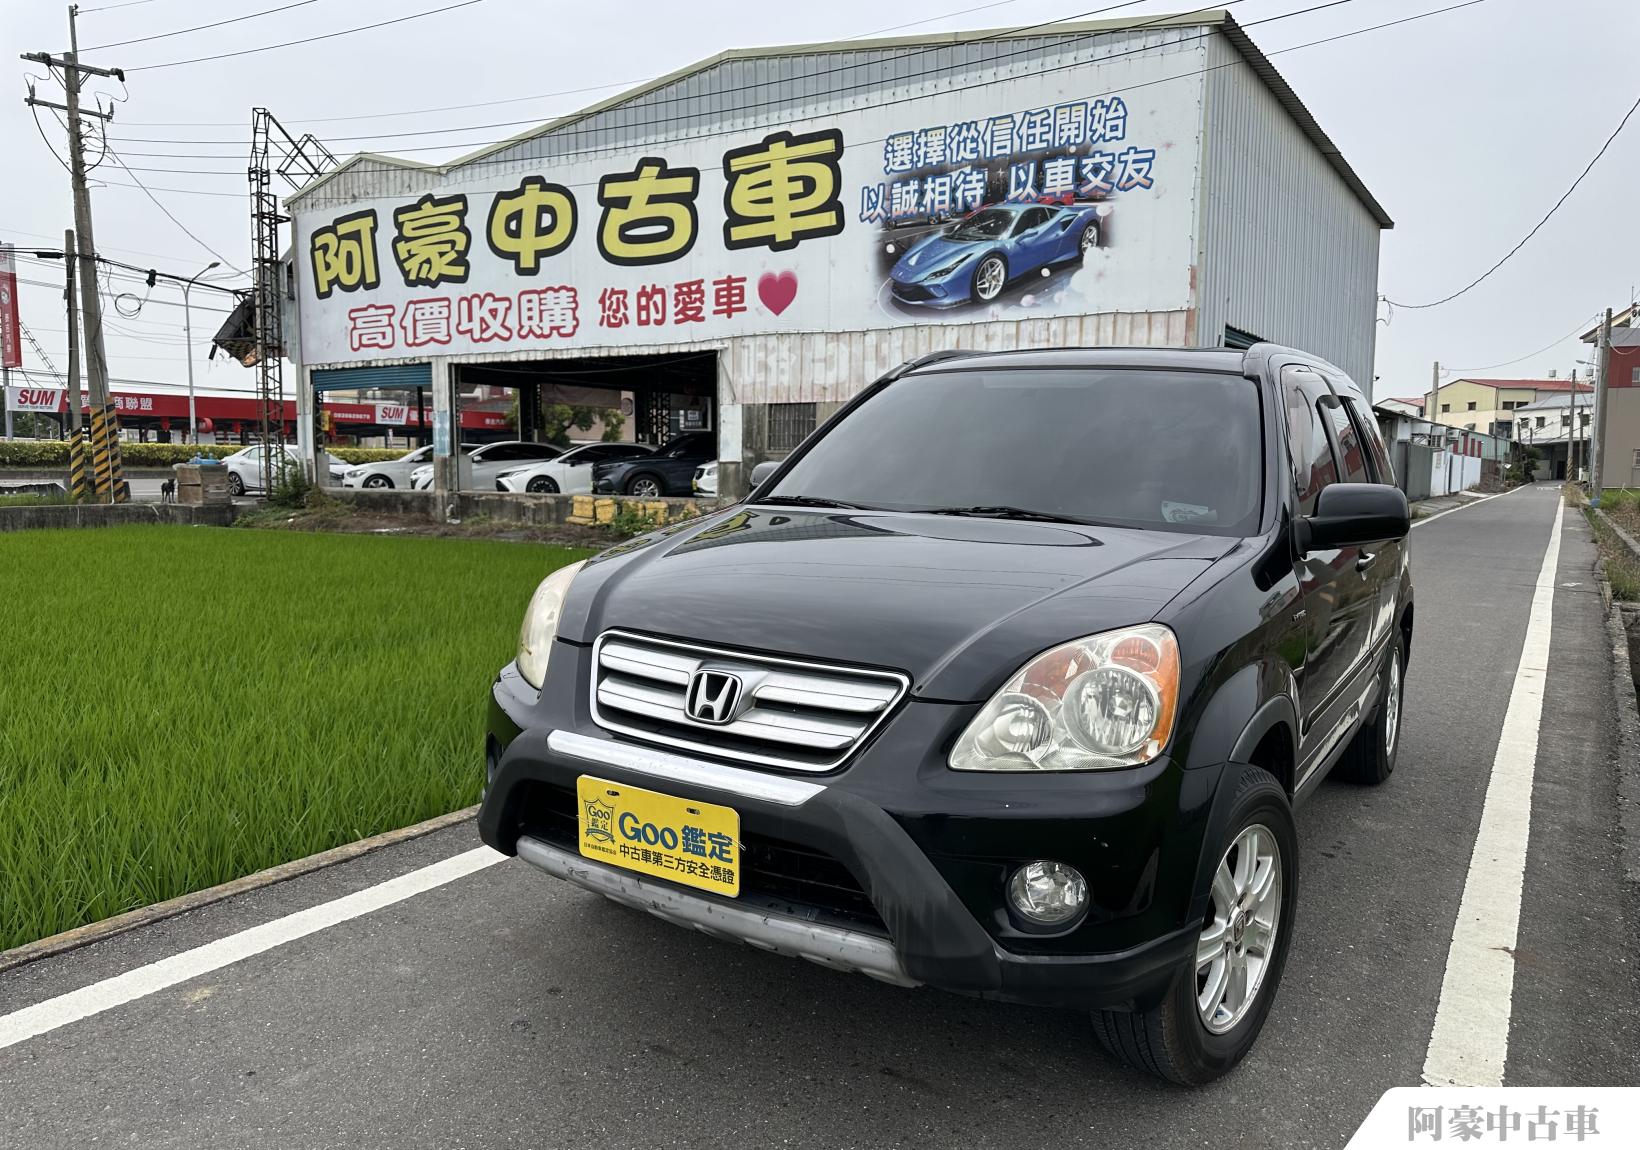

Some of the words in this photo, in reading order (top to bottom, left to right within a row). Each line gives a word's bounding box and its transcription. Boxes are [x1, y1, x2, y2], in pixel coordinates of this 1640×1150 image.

[884, 97, 1127, 174] 選擇從信任開始
[859, 167, 985, 224] 以誠相待
[1008, 147, 1155, 201] 以車交友
[311, 128, 845, 299] 阿豪中古車
[349, 285, 579, 352] 高價收購
[598, 274, 747, 328] 您的愛車
[18, 389, 55, 405] SUM
[381, 406, 404, 419] SUM
[588, 805, 610, 820] Goo
[618, 812, 678, 850] Goo
[681, 825, 734, 864] 鑑定
[619, 843, 735, 885] 中古車第三方安全憑證
